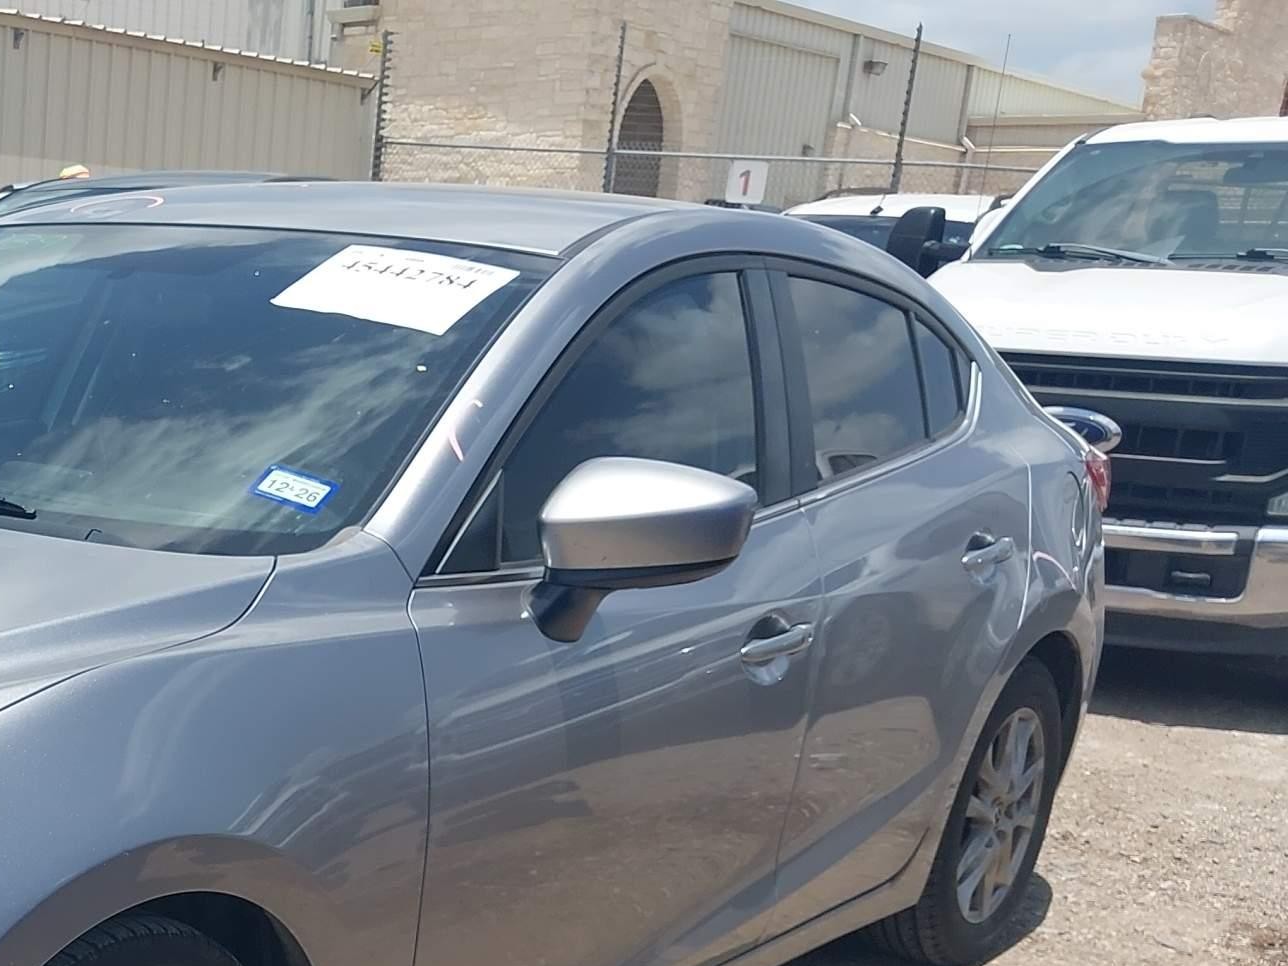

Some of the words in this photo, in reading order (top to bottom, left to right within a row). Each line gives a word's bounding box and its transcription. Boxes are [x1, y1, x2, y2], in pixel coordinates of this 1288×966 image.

[739, 169, 752, 196] 1
[341, 260, 478, 289] 45442784
[267, 479, 290, 493] 12
[294, 488, 321, 503] 26
